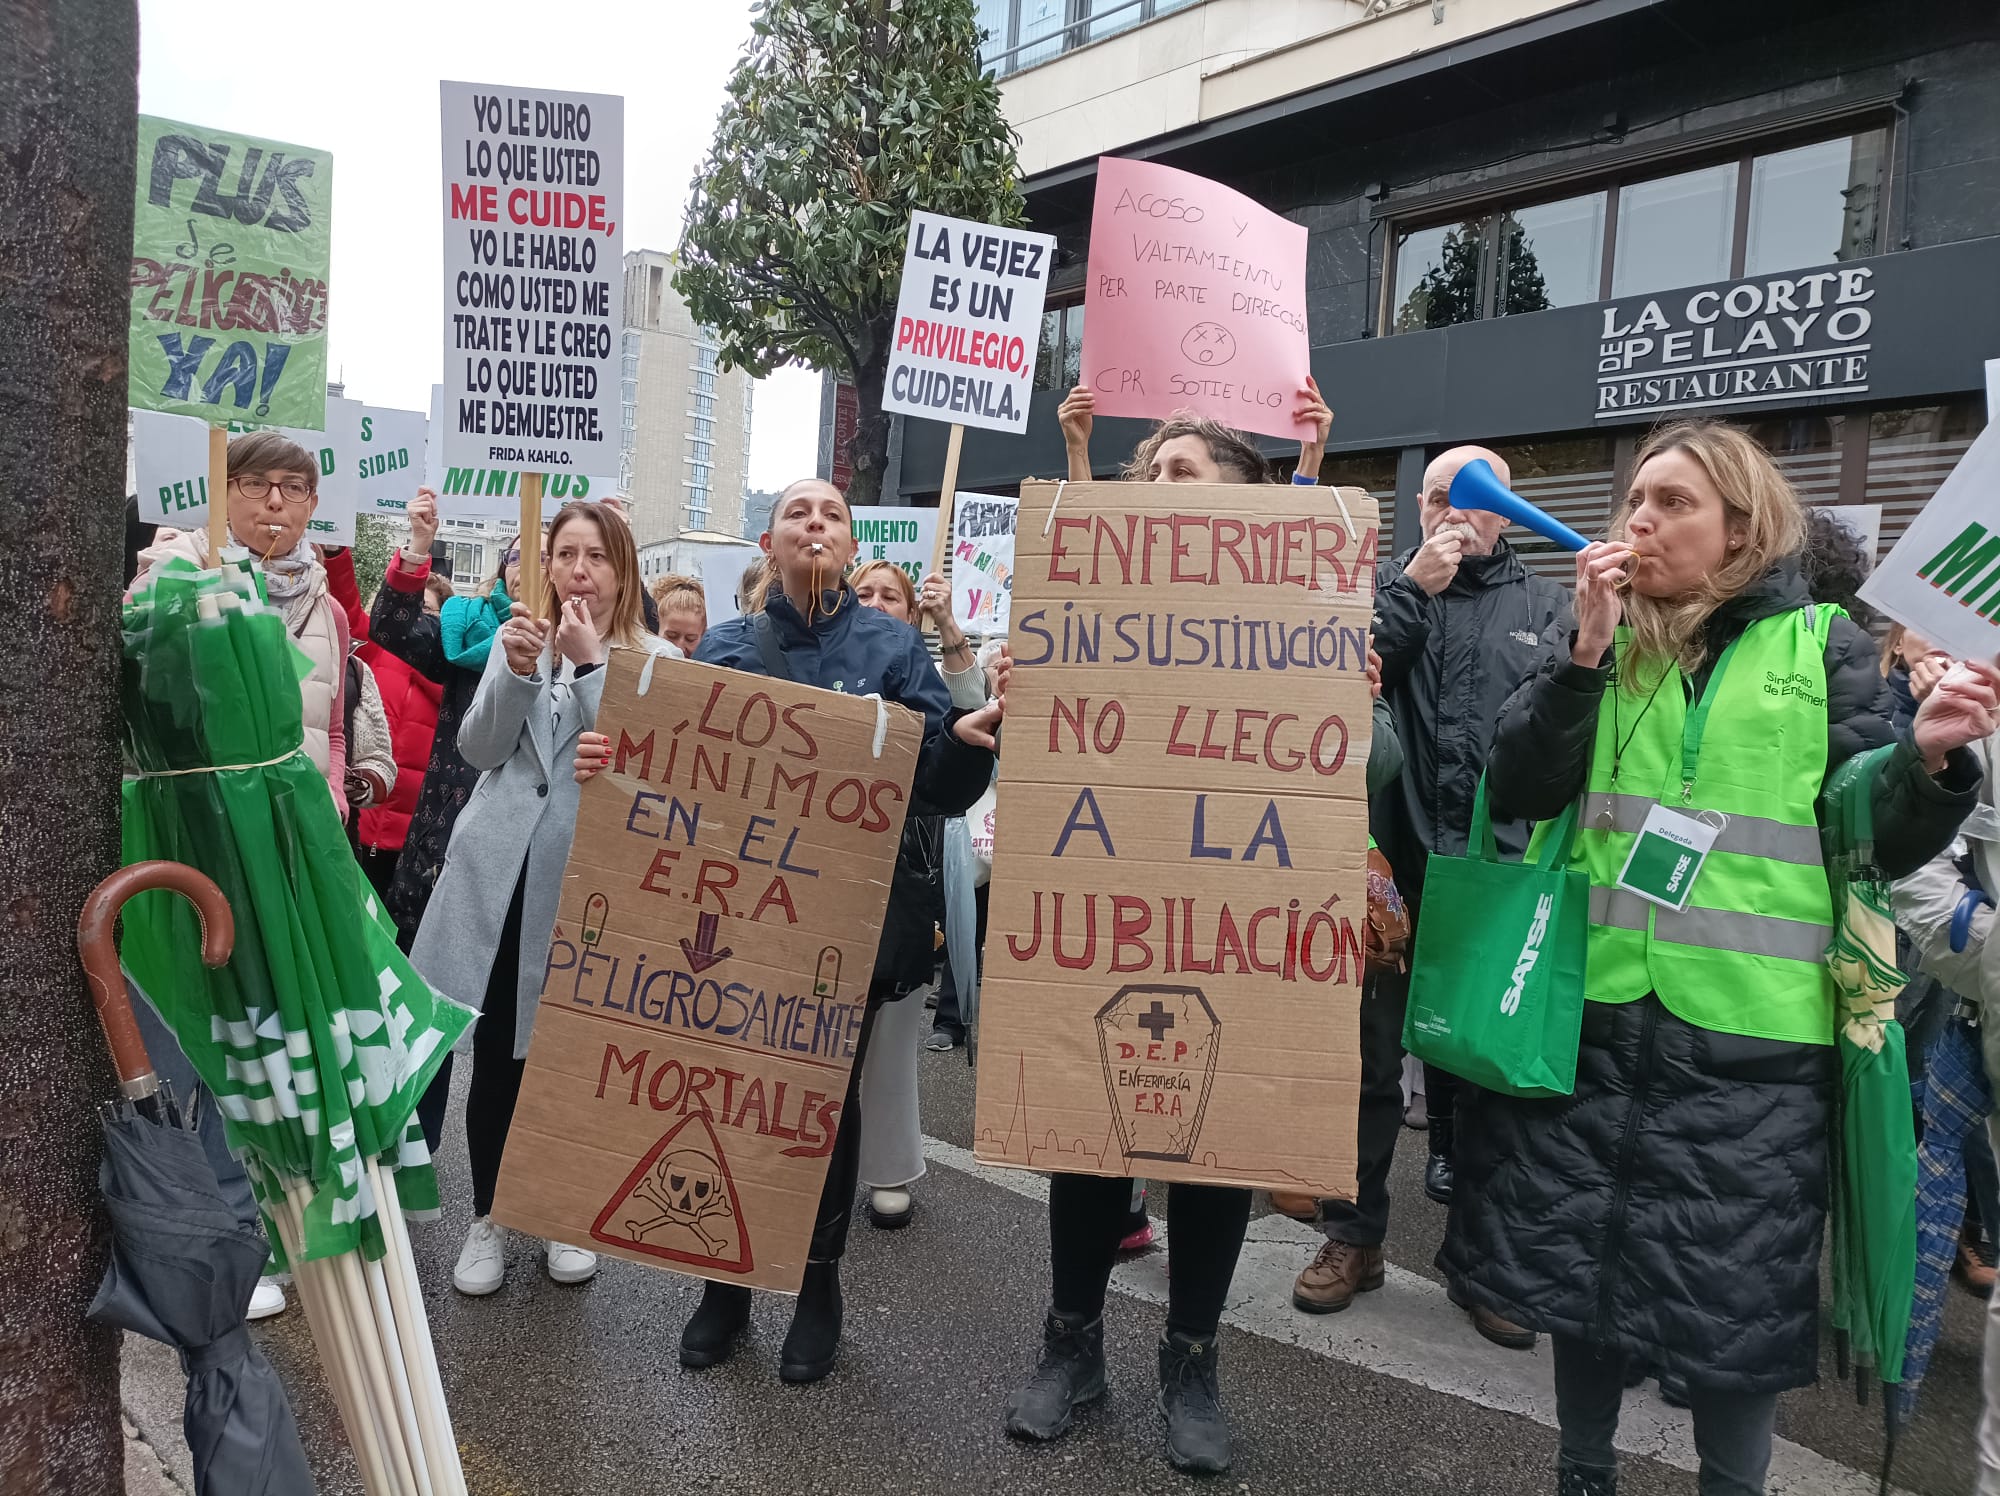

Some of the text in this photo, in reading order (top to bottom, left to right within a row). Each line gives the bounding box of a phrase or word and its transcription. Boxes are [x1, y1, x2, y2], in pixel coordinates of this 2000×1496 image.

[474, 95, 591, 142] YO LE DURO
[148, 134, 316, 232] PLUS
[466, 140, 600, 186] LO QUE USTED
[451, 183, 616, 237] ME CUIDE,
[1114, 188, 1248, 238] ACOSO Y
[176, 219, 236, 264] de
[470, 229, 597, 273] YO LE HABLO
[914, 223, 1044, 279] LA VEJEZ
[457, 271, 609, 316] COMO USTED ME
[929, 275, 1014, 322] ES UN
[1099, 274, 1128, 298] PER
[1155, 280, 1208, 304] PARTE
[1601, 267, 1875, 339] LA CORTE
[453, 314, 611, 359] TRATE Y LE CREO
[897, 316, 1030, 379] PRIVILEGIO,
[1598, 306, 1872, 373] DE PELAYO
[156, 332, 292, 417] YA!
[467, 358, 597, 399] LO QUE USTED
[892, 365, 1021, 421] CUIDENLA.
[1096, 368, 1282, 408] CPR SOTIELLO
[1597, 355, 1868, 410] RESTAURANTE
[459, 399, 603, 442] ME DEMUESTRE.
[489, 447, 573, 465] FRIDA KAHLO.
[852, 519, 918, 543] UMENTO
[873, 545, 885, 560] DE
[1048, 514, 1378, 597] ENFERMERA
[967, 588, 1002, 623] YA!
[1764, 684, 1779, 696] de
[1766, 671, 1813, 688] Sindicato
[698, 682, 819, 760] LOS
[1048, 695, 1348, 776] NO LLEGO
[612, 719, 904, 833] MÍNIMOS
[626, 790, 819, 879] EN EL
[1051, 787, 1293, 869] A LA
[1658, 827, 1693, 846] Delegada
[639, 848, 799, 924] E.R.A
[1666, 853, 1692, 893] SATSE
[1500, 892, 1554, 1017] SATSE
[595, 1043, 842, 1158] MORTALES
[1135, 1092, 1182, 1117] E.R.A
